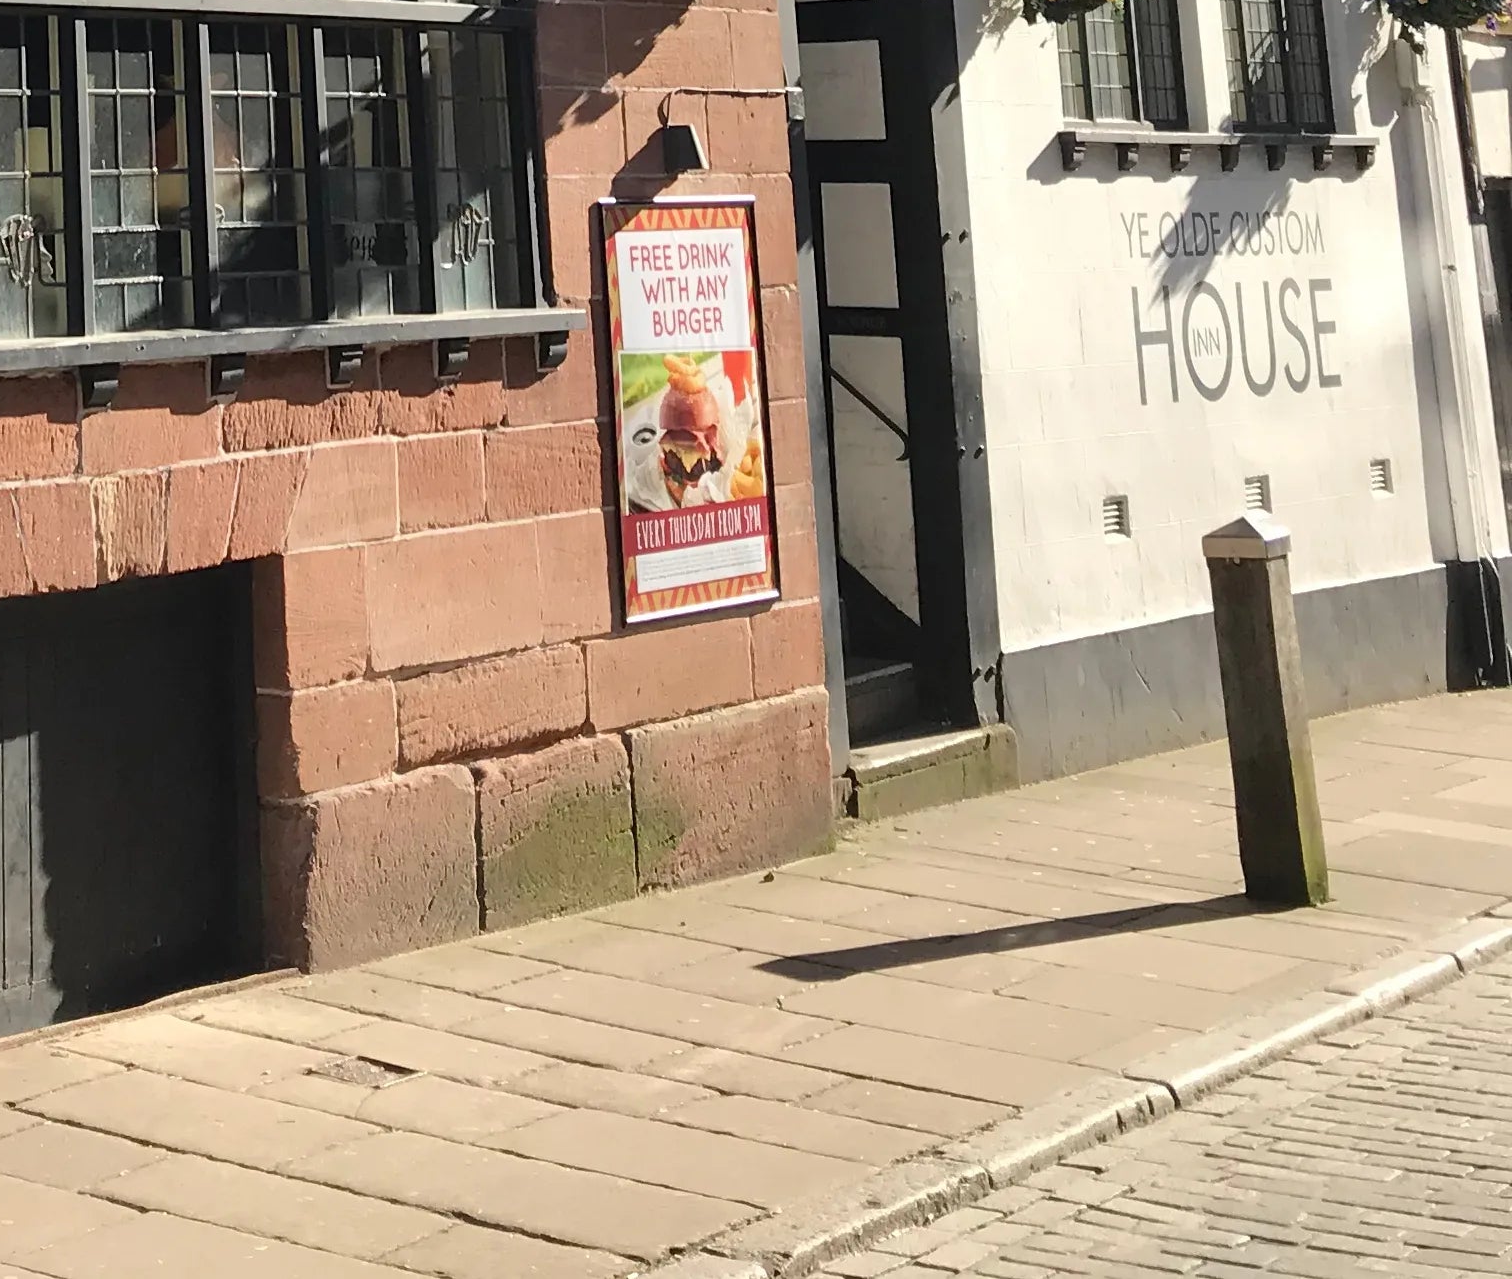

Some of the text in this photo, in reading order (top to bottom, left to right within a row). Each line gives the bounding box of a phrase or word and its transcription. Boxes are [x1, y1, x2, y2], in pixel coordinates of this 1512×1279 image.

[1120, 210, 1325, 258] YE OLDE CUSTOM
[629, 244, 674, 272] FREE
[641, 275, 729, 305] WITH ANY
[652, 306, 724, 337] BURGER
[1131, 277, 1342, 406] HOUSE
[1192, 326, 1221, 357] INN
[636, 504, 762, 550] EVERY THURSDAY FROM 5PM
